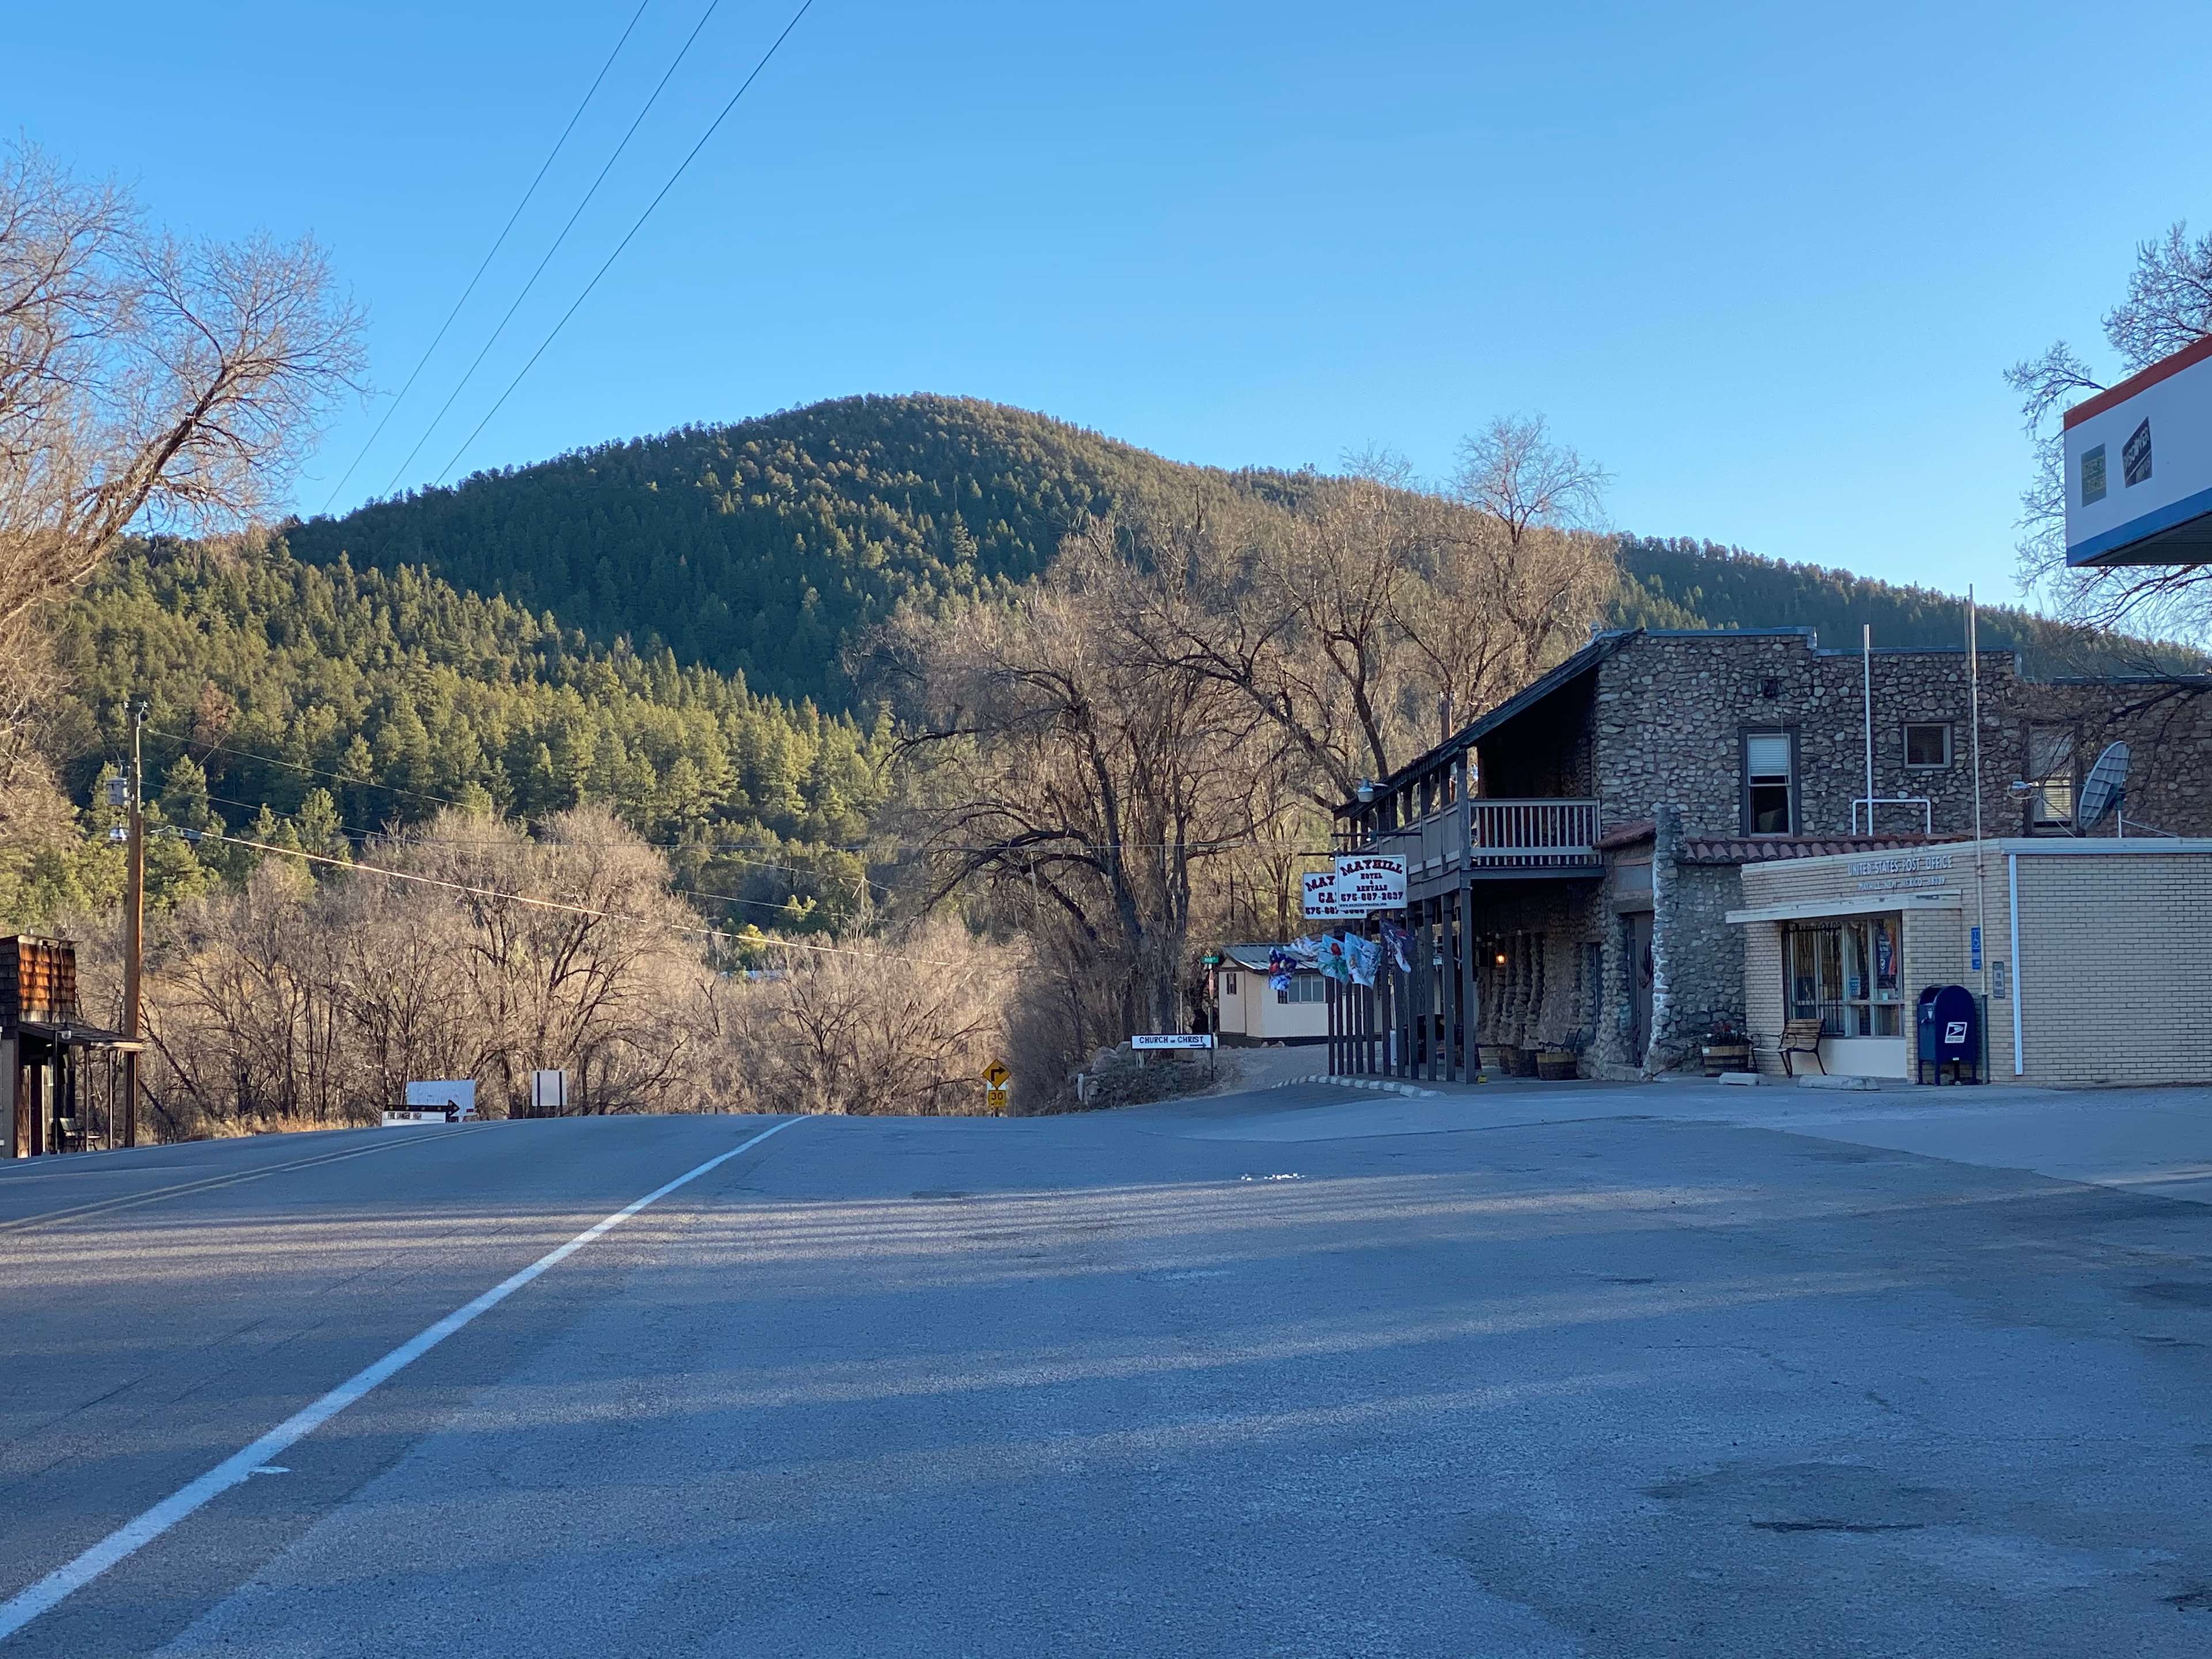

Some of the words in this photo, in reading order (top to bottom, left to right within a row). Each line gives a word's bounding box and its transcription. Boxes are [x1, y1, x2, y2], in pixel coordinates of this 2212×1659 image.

[1340, 859, 1403, 876] MAYHILL
[1847, 863, 1872, 876] UNITED
[1875, 860, 1899, 874] STATES
[1903, 858, 1921, 872] POST
[1926, 855, 1953, 870] OFFICE
[1305, 876, 1336, 892] MAY
[991, 1092, 1003, 1101] 30
